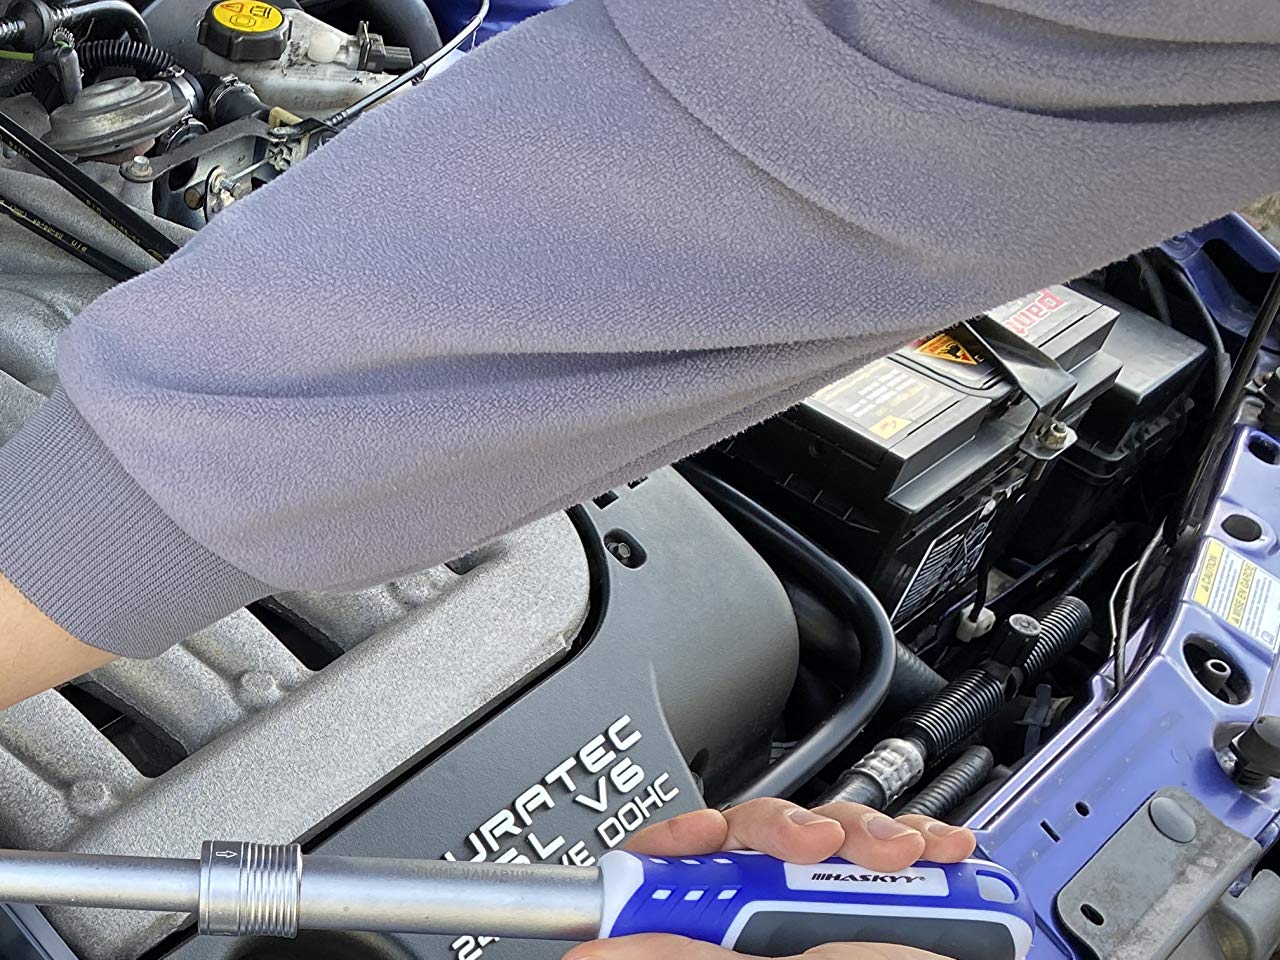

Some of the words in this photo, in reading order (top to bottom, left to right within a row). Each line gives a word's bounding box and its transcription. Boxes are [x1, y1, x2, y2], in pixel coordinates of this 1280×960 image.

[1201, 554, 1217, 584] CAUTION
[1238, 589, 1246, 599] EN
[444, 714, 643, 863] URATEC
[574, 754, 648, 810] V6
[595, 772, 679, 847] DOHC
[824, 871, 919, 885] HASKYY
